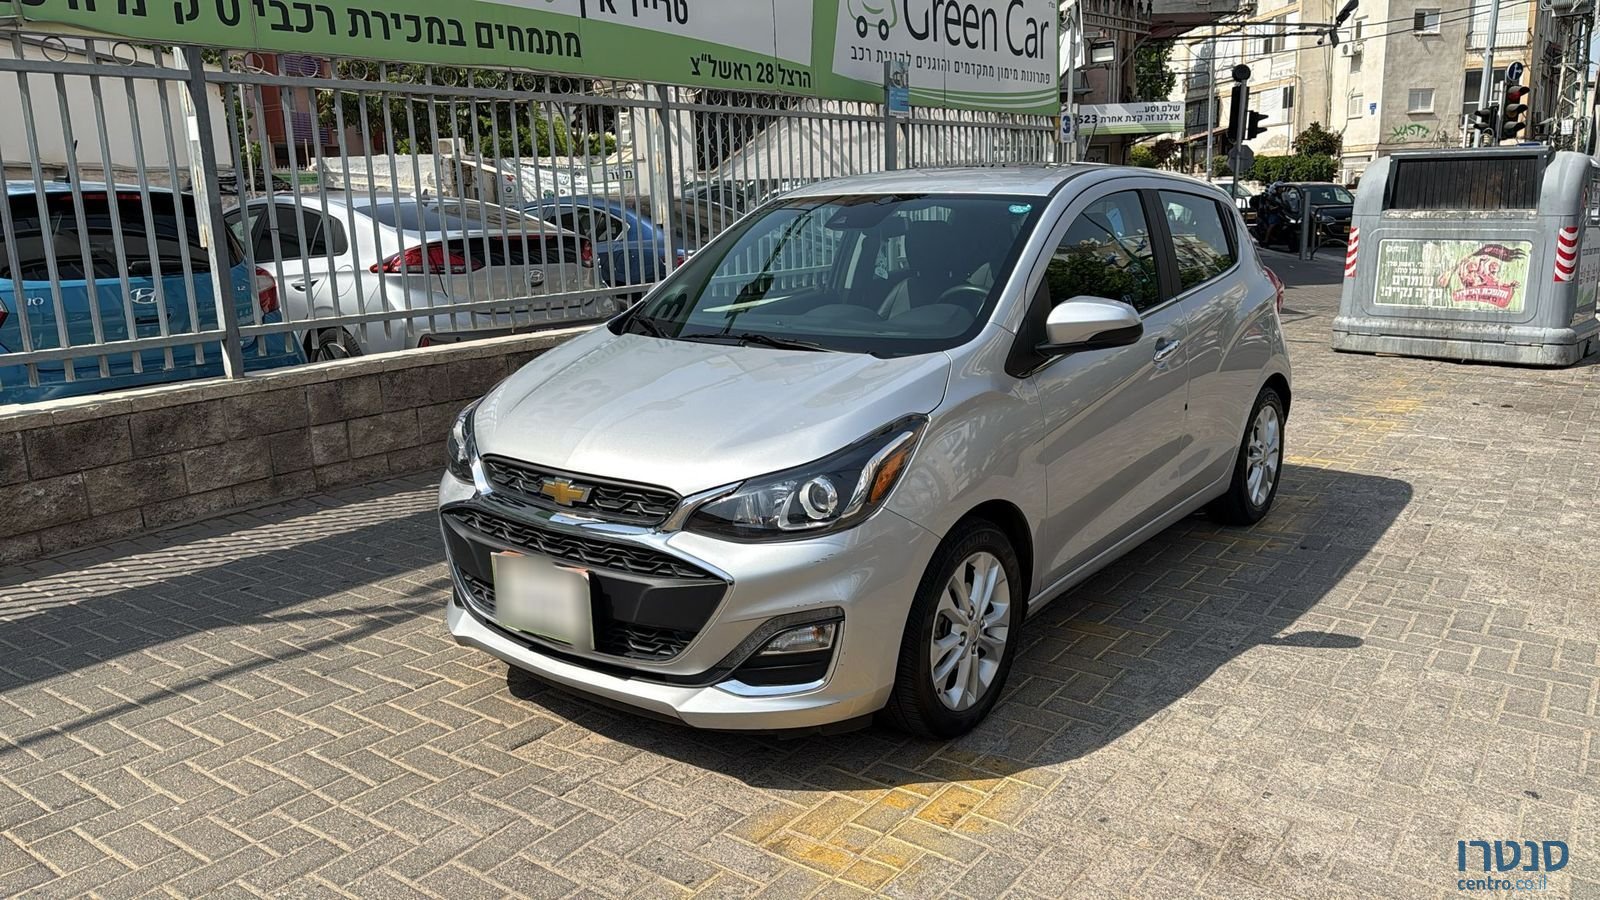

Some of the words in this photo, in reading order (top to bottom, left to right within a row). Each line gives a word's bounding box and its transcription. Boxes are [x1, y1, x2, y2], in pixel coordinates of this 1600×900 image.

[252, 0, 337, 35] רכבי
[346, 7, 467, 47] במכירת
[903, 0, 998, 52] Green
[1005, 0, 1049, 60] Car
[474, 21, 582, 58] מתמחים
[850, 45, 872, 62] רכב
[916, 55, 950, 72] והוגנים
[954, 60, 994, 79] מתקדמים
[756, 62, 774, 84] 28
[778, 63, 812, 88] הרצל
[997, 66, 1018, 81] מימון
[1020, 69, 1050, 84] פתרונות
[1161, 104, 1180, 112] שלם
[1125, 115, 1142, 123] קצת
[1157, 113, 1180, 121] אצלנו
[1391, 275, 1434, 287] שומרים
